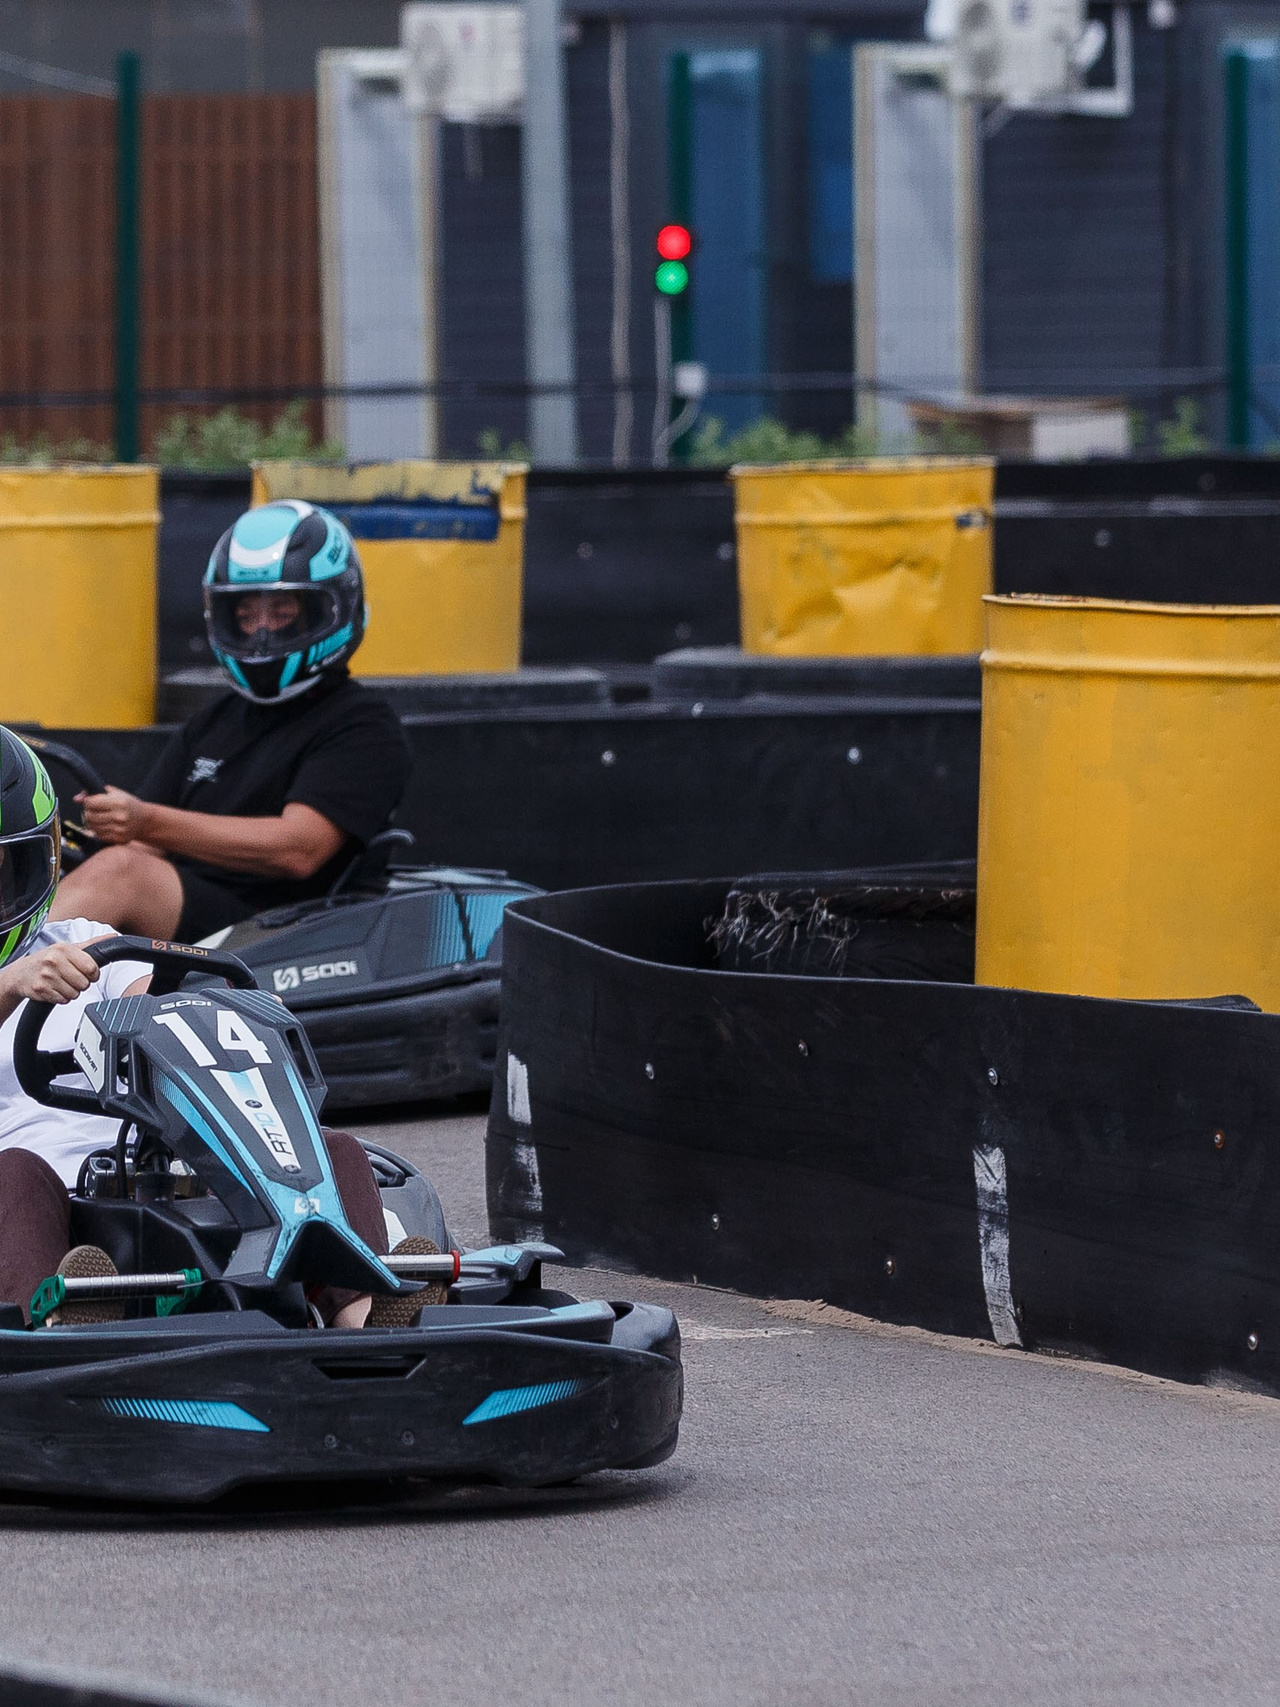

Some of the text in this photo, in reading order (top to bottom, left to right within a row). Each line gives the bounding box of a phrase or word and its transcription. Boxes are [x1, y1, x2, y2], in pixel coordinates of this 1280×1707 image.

[170, 945, 208, 956] SODI
[302, 961, 357, 982] SODI
[160, 1000, 212, 1010] SODI
[152, 1010, 272, 1067] 14
[253, 1112, 293, 1155] RT10
